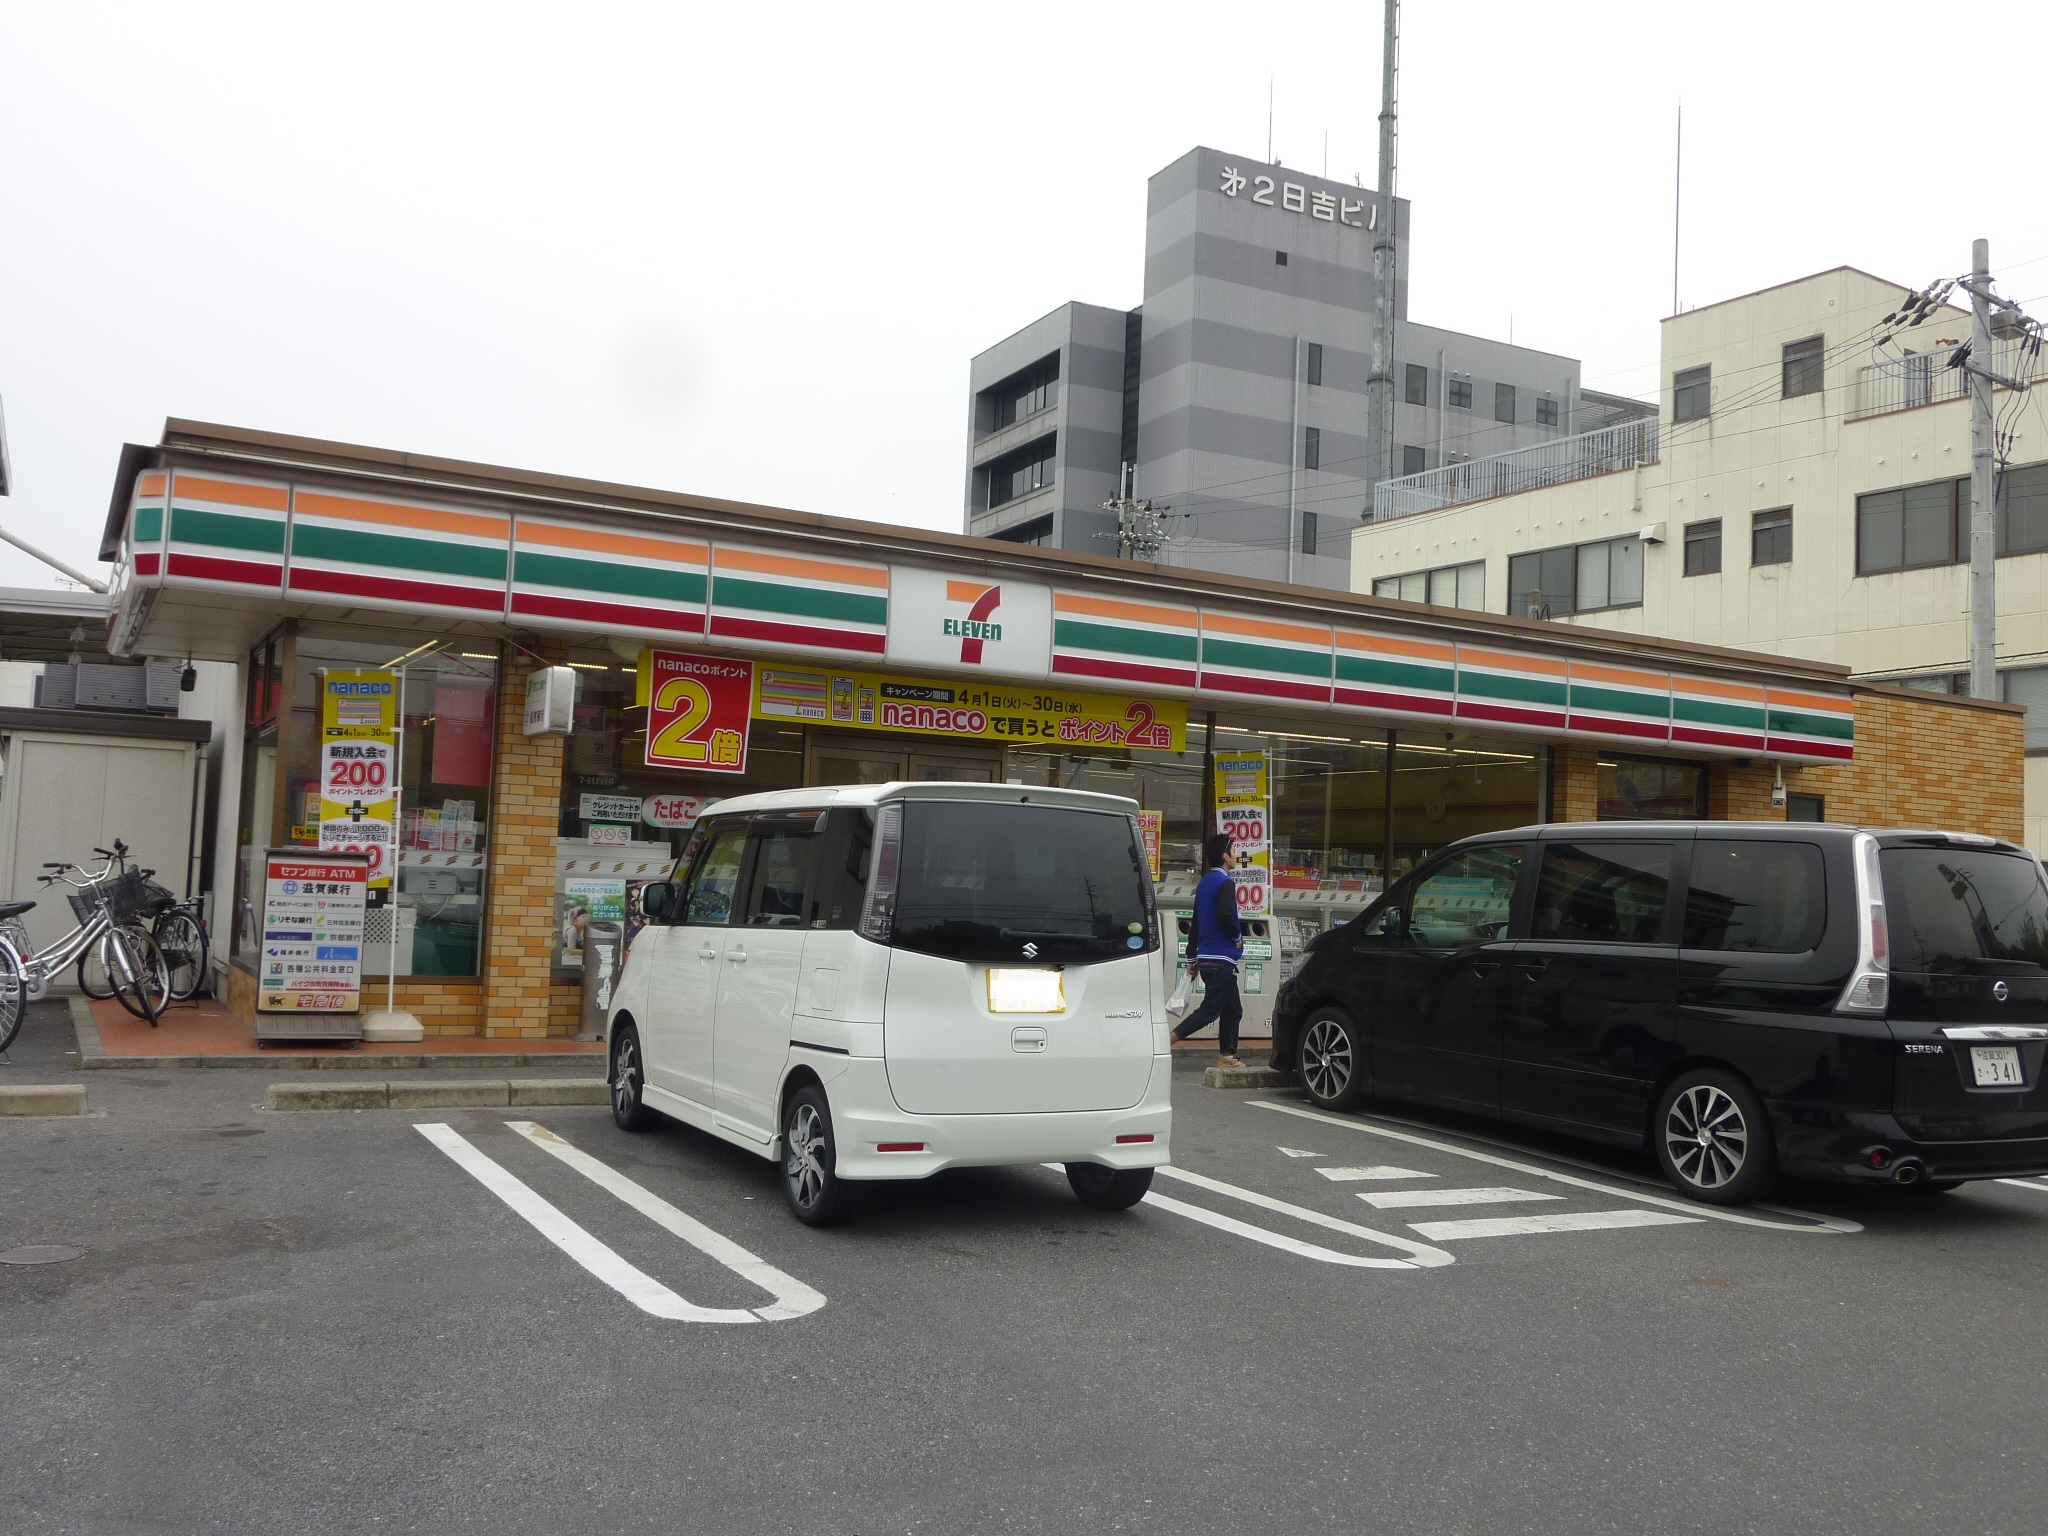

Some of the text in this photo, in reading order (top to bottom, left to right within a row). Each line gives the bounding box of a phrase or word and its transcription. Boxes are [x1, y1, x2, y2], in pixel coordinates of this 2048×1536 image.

[657, 659, 748, 679] nanacoポイント
[327, 681, 393, 696] nanaco
[886, 685, 950, 701] キャンペーン期間
[650, 677, 743, 765] 2倍
[329, 745, 388, 759] 新規入会で
[1217, 761, 1263, 771] nanaco
[329, 759, 387, 788] 200
[328, 787, 386, 796] ポイントプレゼント
[592, 802, 641, 812] クレジットカードが
[653, 799, 697, 820] たばこ
[1221, 810, 1263, 820] 新規入会で
[661, 819, 689, 827] cigarette
[1222, 821, 1264, 842] 200
[280, 866, 326, 878] セブン銀行
[329, 869, 356, 879] ATM
[302, 882, 351, 896] 滋賀銀行
[277, 916, 313, 924] りそな銀行
[329, 934, 361, 942] 京都銀行
[287, 964, 354, 974] 各種公共料金窓口
[298, 995, 346, 1008] 宅急便
[1904, 1044, 1944, 1054] SERENA
